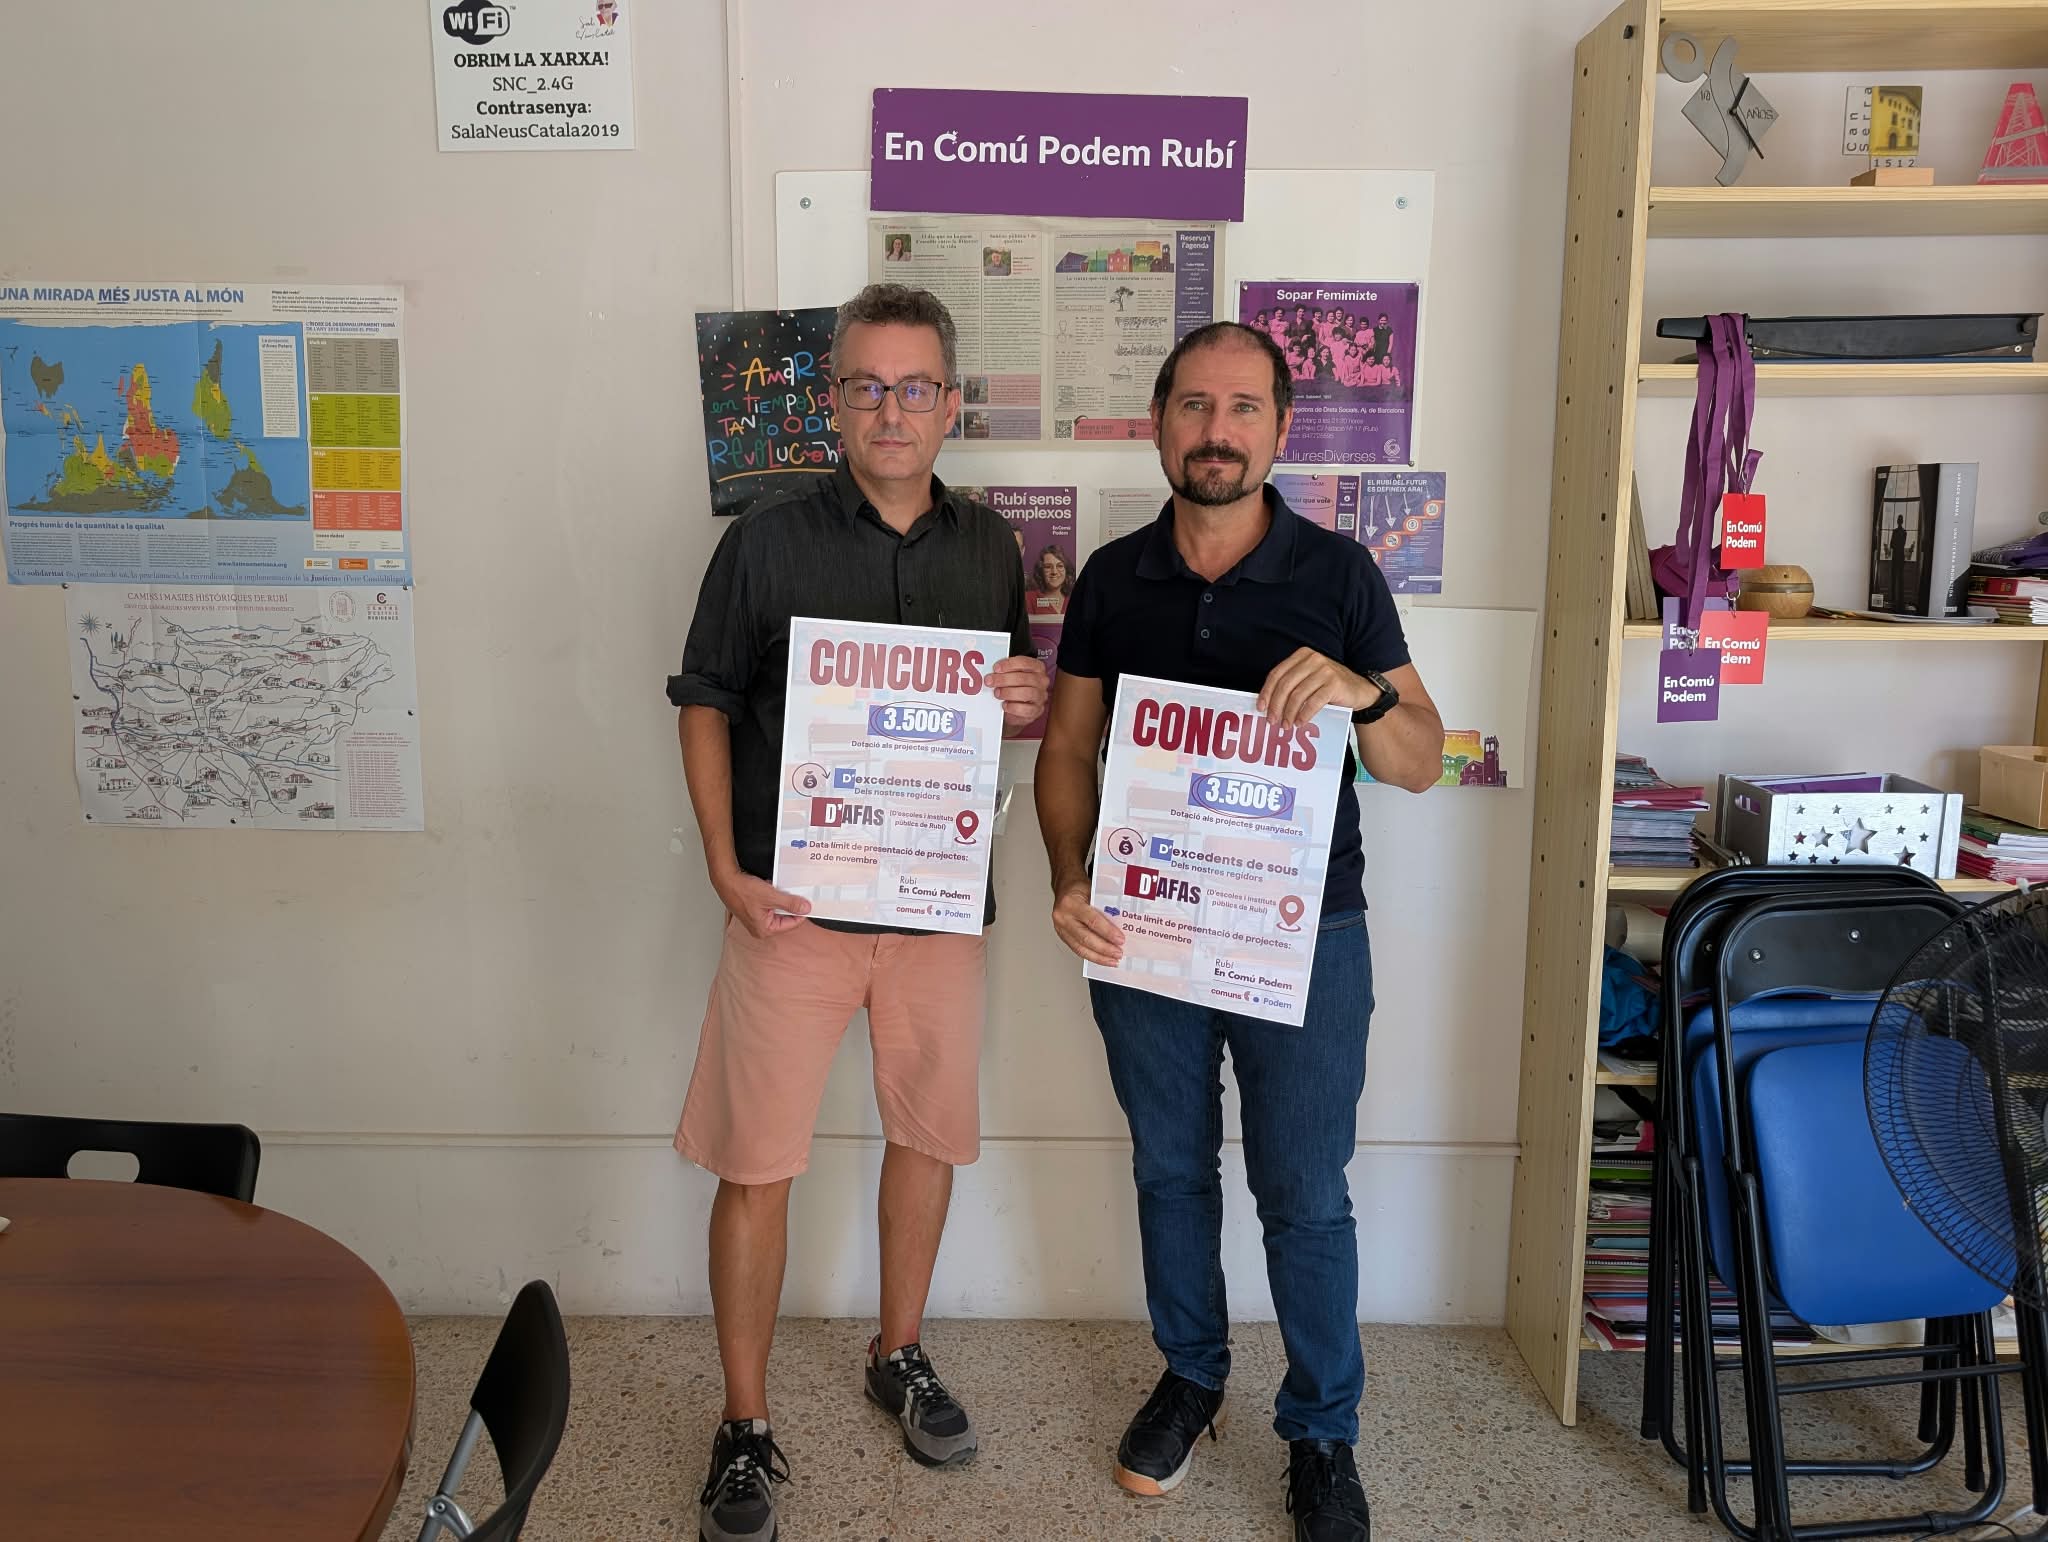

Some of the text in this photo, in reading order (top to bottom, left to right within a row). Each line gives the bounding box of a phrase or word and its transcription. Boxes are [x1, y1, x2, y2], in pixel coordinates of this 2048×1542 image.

[454, 52, 609, 67] OBRIM LA XARXA!
[492, 76, 573, 94] SNC_2.4G
[476, 101, 592, 117] Contrasenya:
[1860, 87, 1872, 152] Serra
[451, 124, 620, 139] SalaNeusCatala2019
[1847, 112, 1858, 152] Can
[885, 132, 1237, 169] En Comú Podem Rubí
[33, 288, 95, 301] MIRADA
[98, 286, 130, 302] MÉS
[133, 289, 180, 302] JUSTA
[183, 289, 204, 302] AL
[206, 287, 244, 303] MÓN
[1277, 289, 1313, 302] Sopar
[993, 492, 1071, 505] Rubí sense
[65, 521, 74, 529] de
[1727, 521, 1762, 533] En Comú
[1726, 536, 1757, 548] Podem
[1670, 624, 1685, 635] En
[1705, 637, 1760, 650] En Comú
[1721, 653, 1751, 664] dem
[810, 639, 984, 695] CONCURS
[1664, 675, 1714, 688] En Comú
[1664, 692, 1706, 702] Podem
[884, 708, 953, 733] 3.500€
[1132, 698, 1321, 771] CONCURS
[851, 740, 880, 748] Dotació
[894, 743, 929, 752] projectes
[931, 745, 974, 755] guanyadors
[842, 773, 972, 793] D'excedents de sous
[874, 789, 905, 797] nostres
[907, 791, 940, 800] regidors
[1205, 777, 1283, 811] 3.500€
[1170, 809, 1303, 837] Dotació als projectes guanyadors
[809, 840, 828, 848] Data
[830, 841, 850, 850] límit
[864, 844, 912, 856] presentació
[915, 849, 925, 857] de
[926, 849, 969, 861] projectes:
[836, 855, 877, 864] novembre
[1159, 843, 1298, 876] D'excedents de sous
[1171, 860, 1263, 882] Dels nostres regidors
[900, 876, 917, 885] Rubí
[899, 886, 971, 900] En Comú Podem
[1139, 873, 1200, 905] D'AFAS
[1207, 888, 1243, 900] (D'escoles
[896, 906, 925, 914] comuns
[945, 910, 971, 919] Podem
[1212, 899, 1238, 909] públics
[1249, 905, 1268, 915] Rubí)
[1122, 910, 1291, 950] Data límit de presentació de projectes:
[1122, 923, 1192, 944] 20 de novembre
[1215, 959, 1234, 969] Rubí
[1214, 967, 1293, 991] En Comú Podem
[1211, 989, 1242, 1000] comuns
[1263, 997, 1292, 1009] Podem
